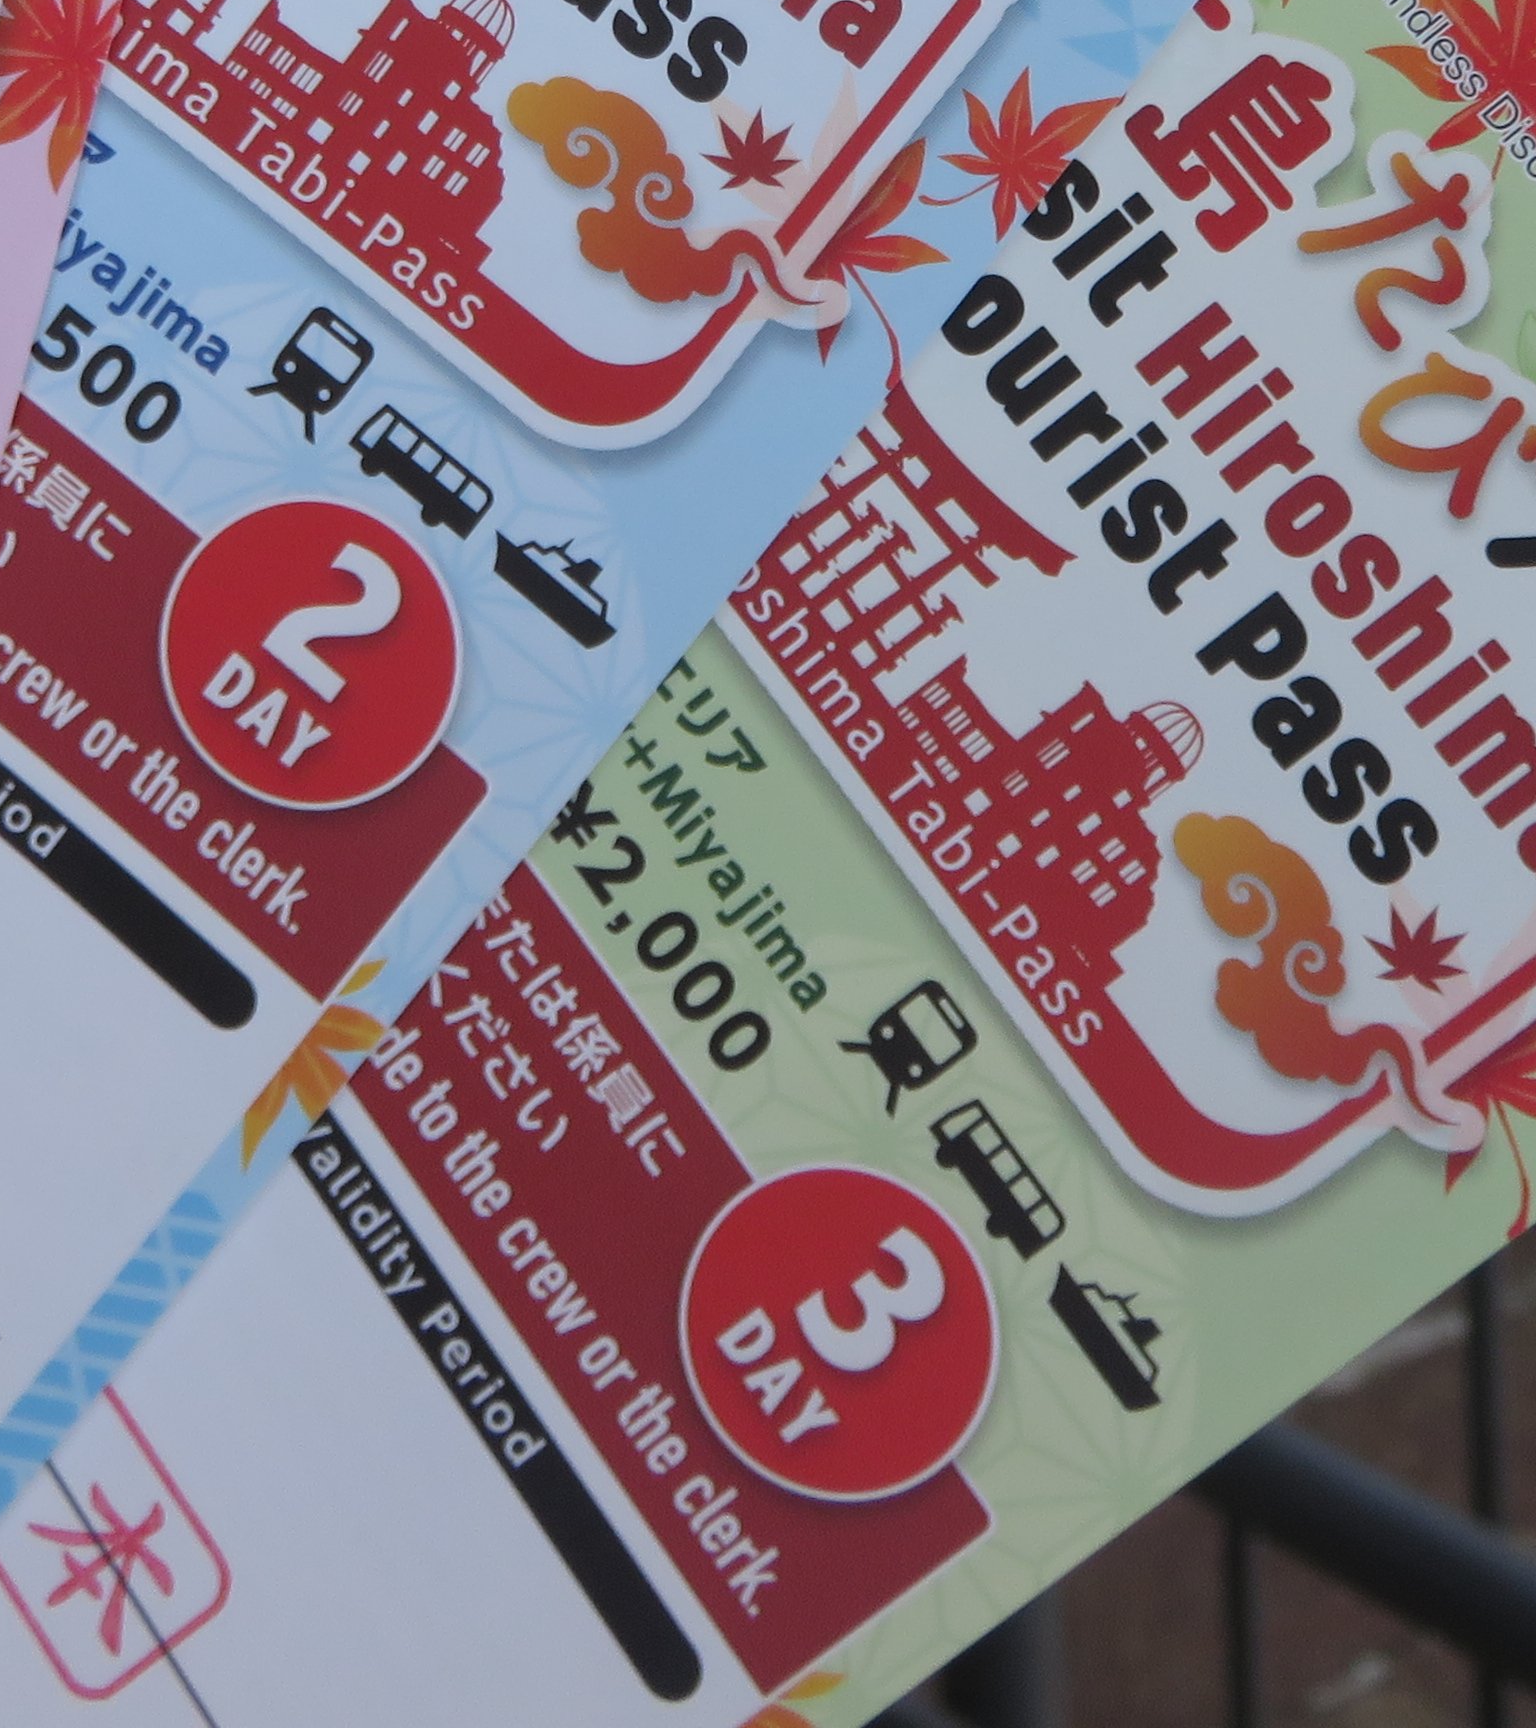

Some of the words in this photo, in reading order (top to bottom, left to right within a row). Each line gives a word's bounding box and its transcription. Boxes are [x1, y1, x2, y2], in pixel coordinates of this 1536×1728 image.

[234, 108, 484, 329] Tabi-Pass
[203, 652, 331, 769] DAY
[263, 542, 402, 704] 2
[81, 720, 138, 771] or
[130, 748, 200, 829] the
[198, 823, 312, 934] clerk.
[1196, 592, 1438, 884] Pass
[888, 760, 1103, 1047] Tabi-Pass
[408, 1080, 458, 1141] to
[444, 1128, 511, 1218] the
[497, 1218, 597, 1334] crew
[579, 1335, 638, 1391] or
[616, 1387, 689, 1475] the
[673, 1474, 779, 1618] clerk.
[420, 1302, 547, 1468] Period
[717, 1309, 839, 1444] DAY
[796, 1226, 946, 1372] 3
